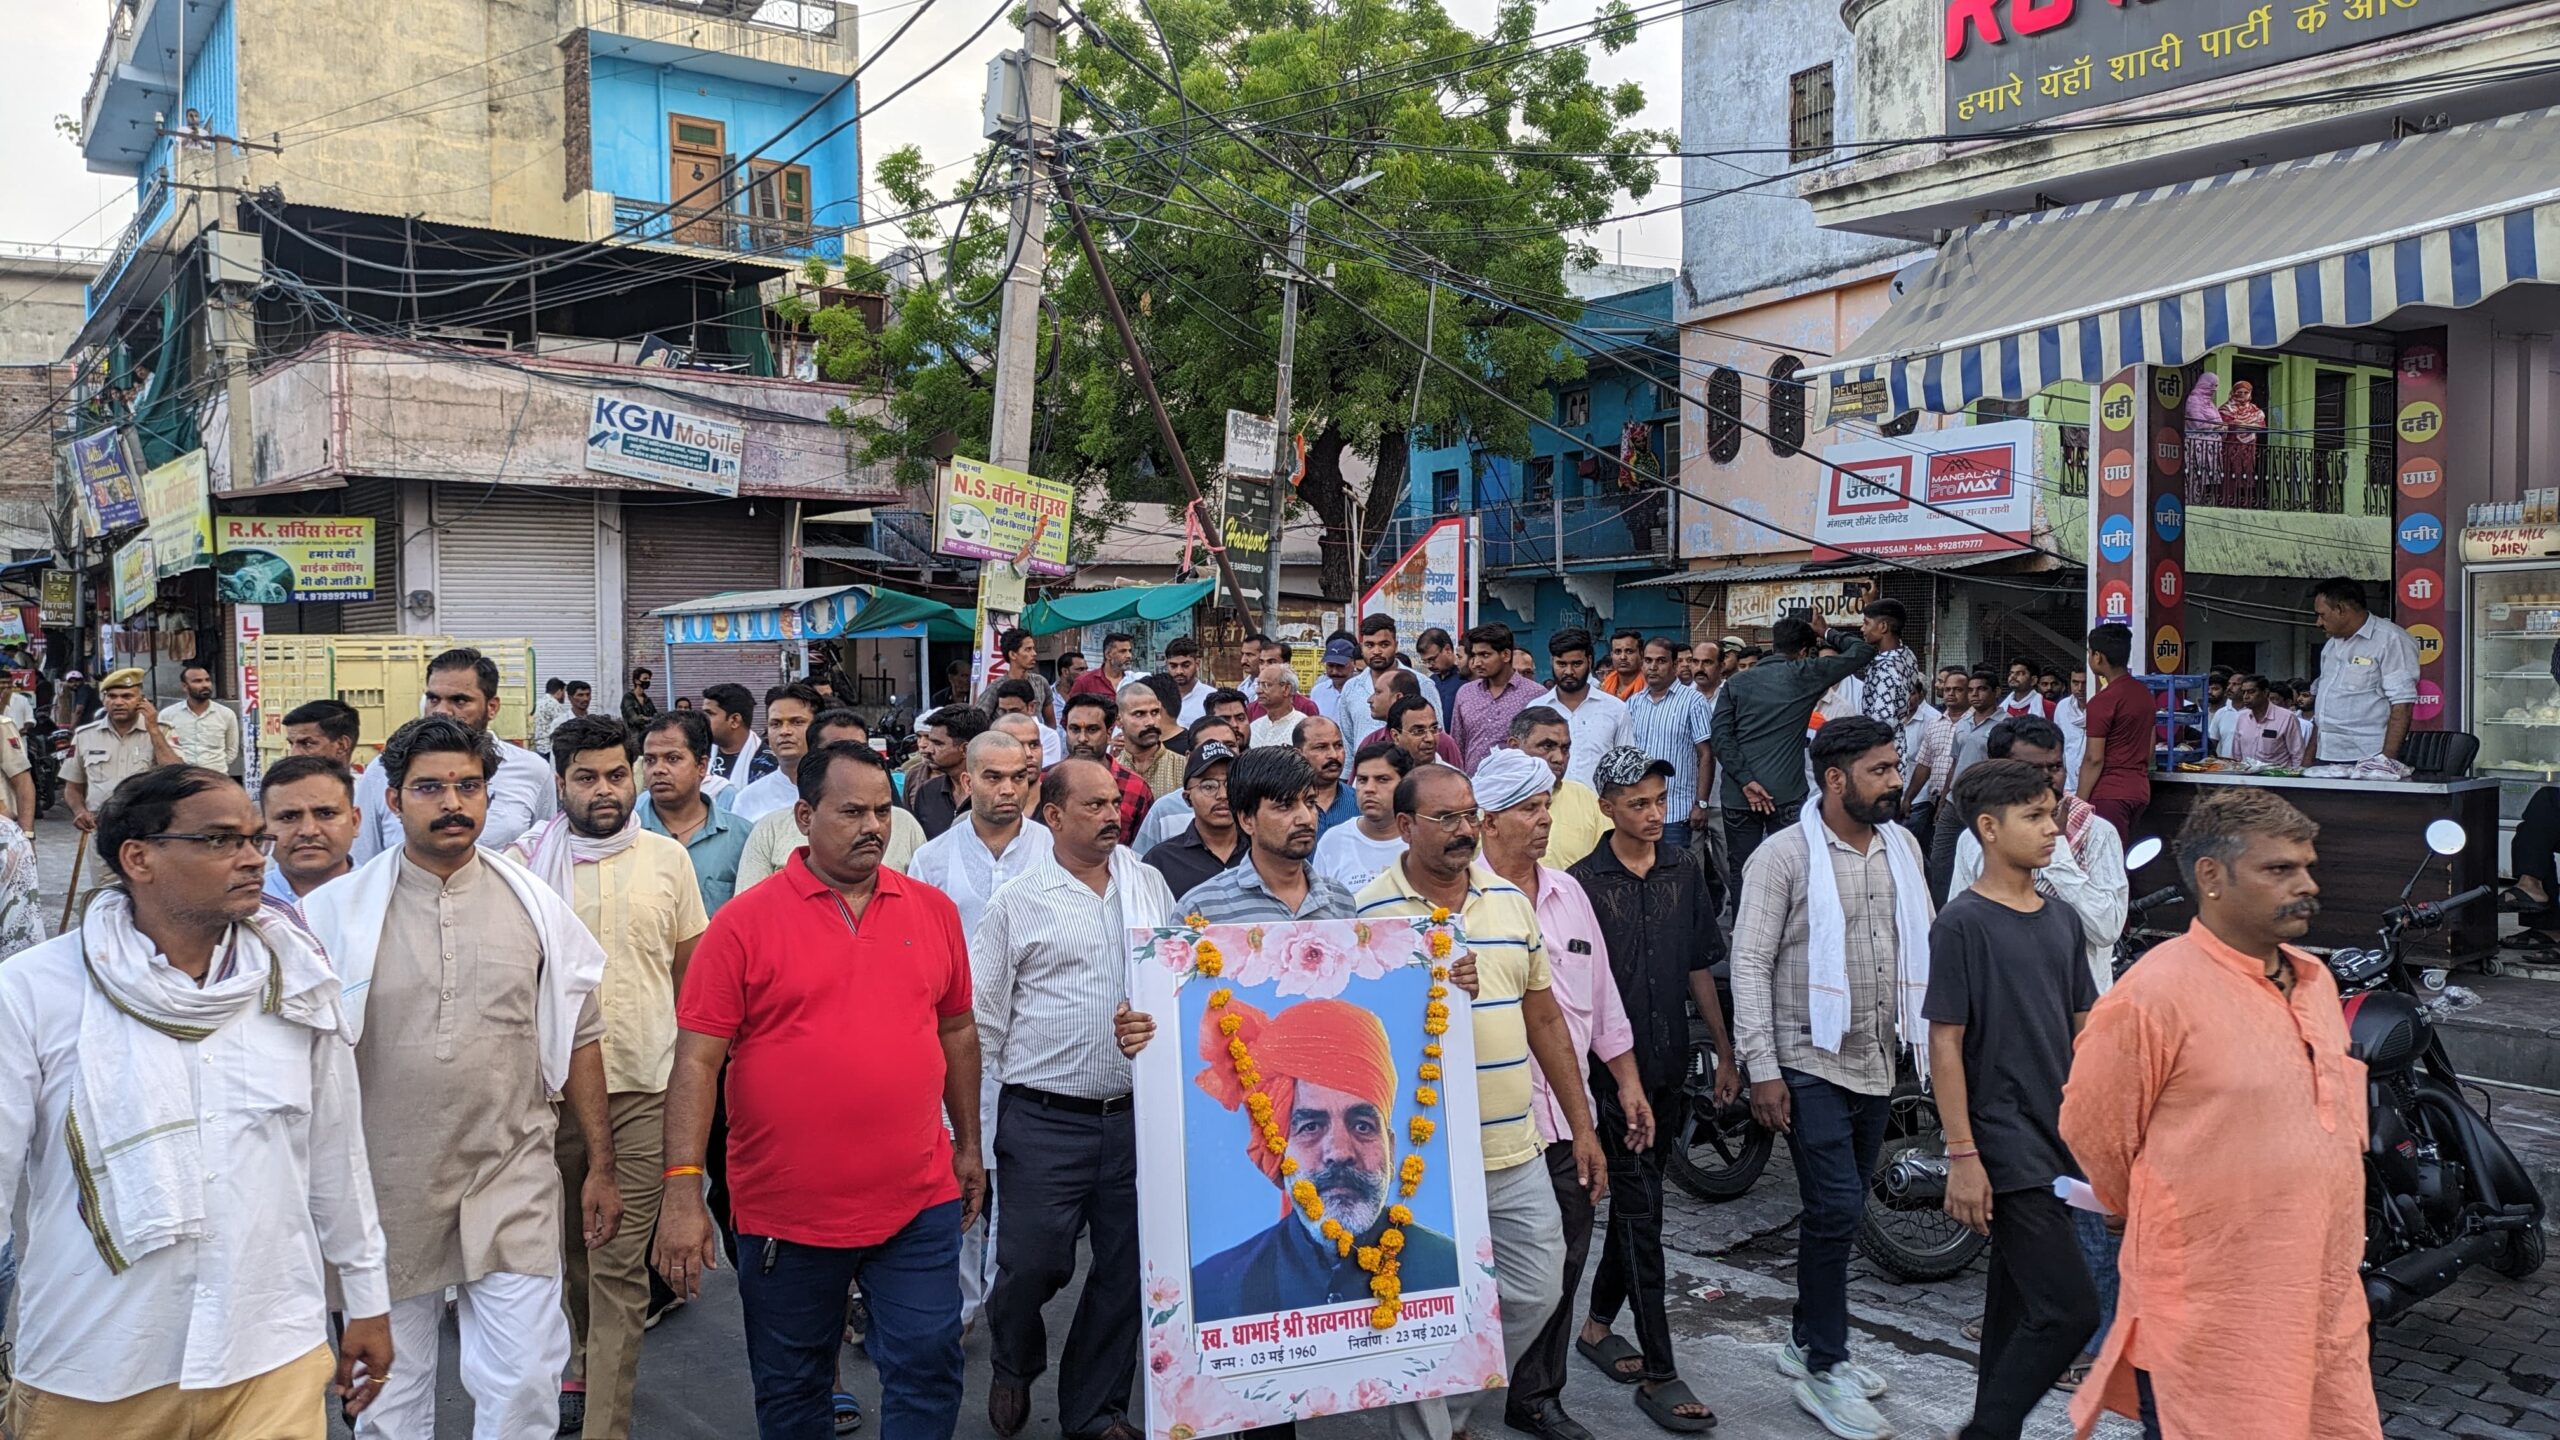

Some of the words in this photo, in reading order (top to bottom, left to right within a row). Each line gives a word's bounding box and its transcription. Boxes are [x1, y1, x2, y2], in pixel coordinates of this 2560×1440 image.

[1958, 72, 2023, 120] हमारे
[2108, 33, 2183, 81] शादी
[2198, 3, 2275, 58] पार्टी
[1834, 382, 1862, 397] DELHI
[2158, 375, 2181, 398] दही
[2104, 395, 2133, 419] दही
[595, 397, 675, 440] KGN
[675, 421, 742, 455] Mobile
[2401, 411, 2438, 432] दही
[1932, 469, 2000, 483] MANGALAM
[2104, 465, 2131, 481] छाछ
[2402, 469, 2437, 485] छाछ
[1930, 478, 1997, 497] ProMAX
[992, 482, 1027, 509] बर्तन
[1030, 493, 1068, 518] हाउस
[1989, 504, 2010, 514] साथी
[2156, 509, 2181, 526] पनीर
[229, 521, 273, 538] R.K.
[277, 521, 321, 538] सर्विस
[325, 521, 362, 538] सेन्टर
[1225, 516, 1269, 558] Hairport
[2102, 530, 2132, 547] पनीर
[2401, 526, 2439, 541] पनीर
[2477, 528, 2514, 542] ROYAL
[2519, 527, 2547, 540] MILK
[309, 549, 334, 558] हमारे
[1872, 544, 1907, 554] HUSSAIN
[1938, 540, 1983, 550] 9928179777
[2492, 543, 2528, 556] DAIRY
[301, 576, 313, 586] भी
[314, 576, 328, 586] की
[330, 575, 353, 586] जाती
[2161, 572, 2176, 595] घी
[2408, 579, 2432, 598] घी
[2107, 592, 2126, 615] घी
[2157, 640, 2179, 658] क्रीम
[1201, 1328, 1228, 1351] स्व.
[1232, 1313, 1280, 1345] धाभाई
[1283, 1311, 1303, 1338] श्री
[1348, 1331, 1383, 1351] निर्वाण
[1396, 1330, 1410, 1343] 23
[1411, 1323, 1427, 1342] मई
[1430, 1323, 1457, 1338] 2024
[1210, 1356, 1236, 1371] जन्म
[1251, 1351, 1265, 1365] 03
[1268, 1345, 1285, 1364] मई
[1288, 1344, 1317, 1360] 1960
